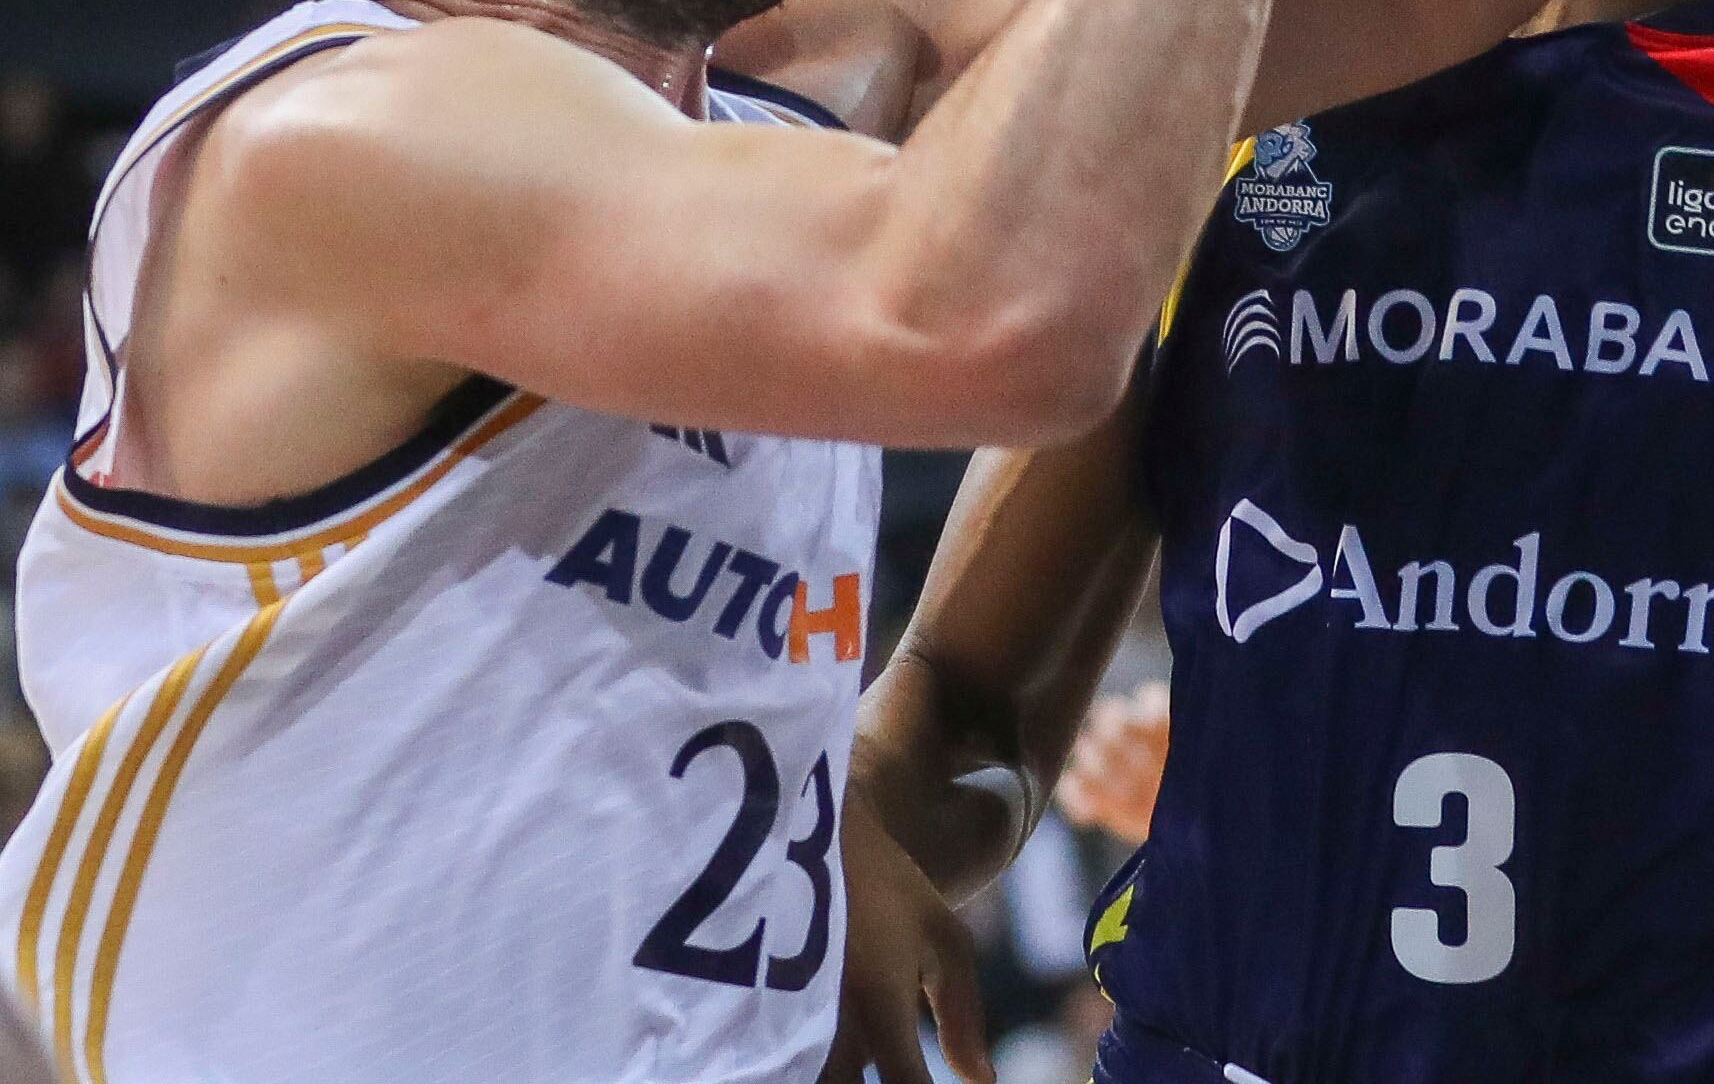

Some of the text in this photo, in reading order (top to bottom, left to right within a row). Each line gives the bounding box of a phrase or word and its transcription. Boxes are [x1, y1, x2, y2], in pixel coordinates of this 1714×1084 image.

[1240, 197, 1326, 218] ANDORRA
[1241, 182, 1328, 198] MORABANC
[633, 719, 836, 992] 23
[1390, 751, 1516, 984] 3
